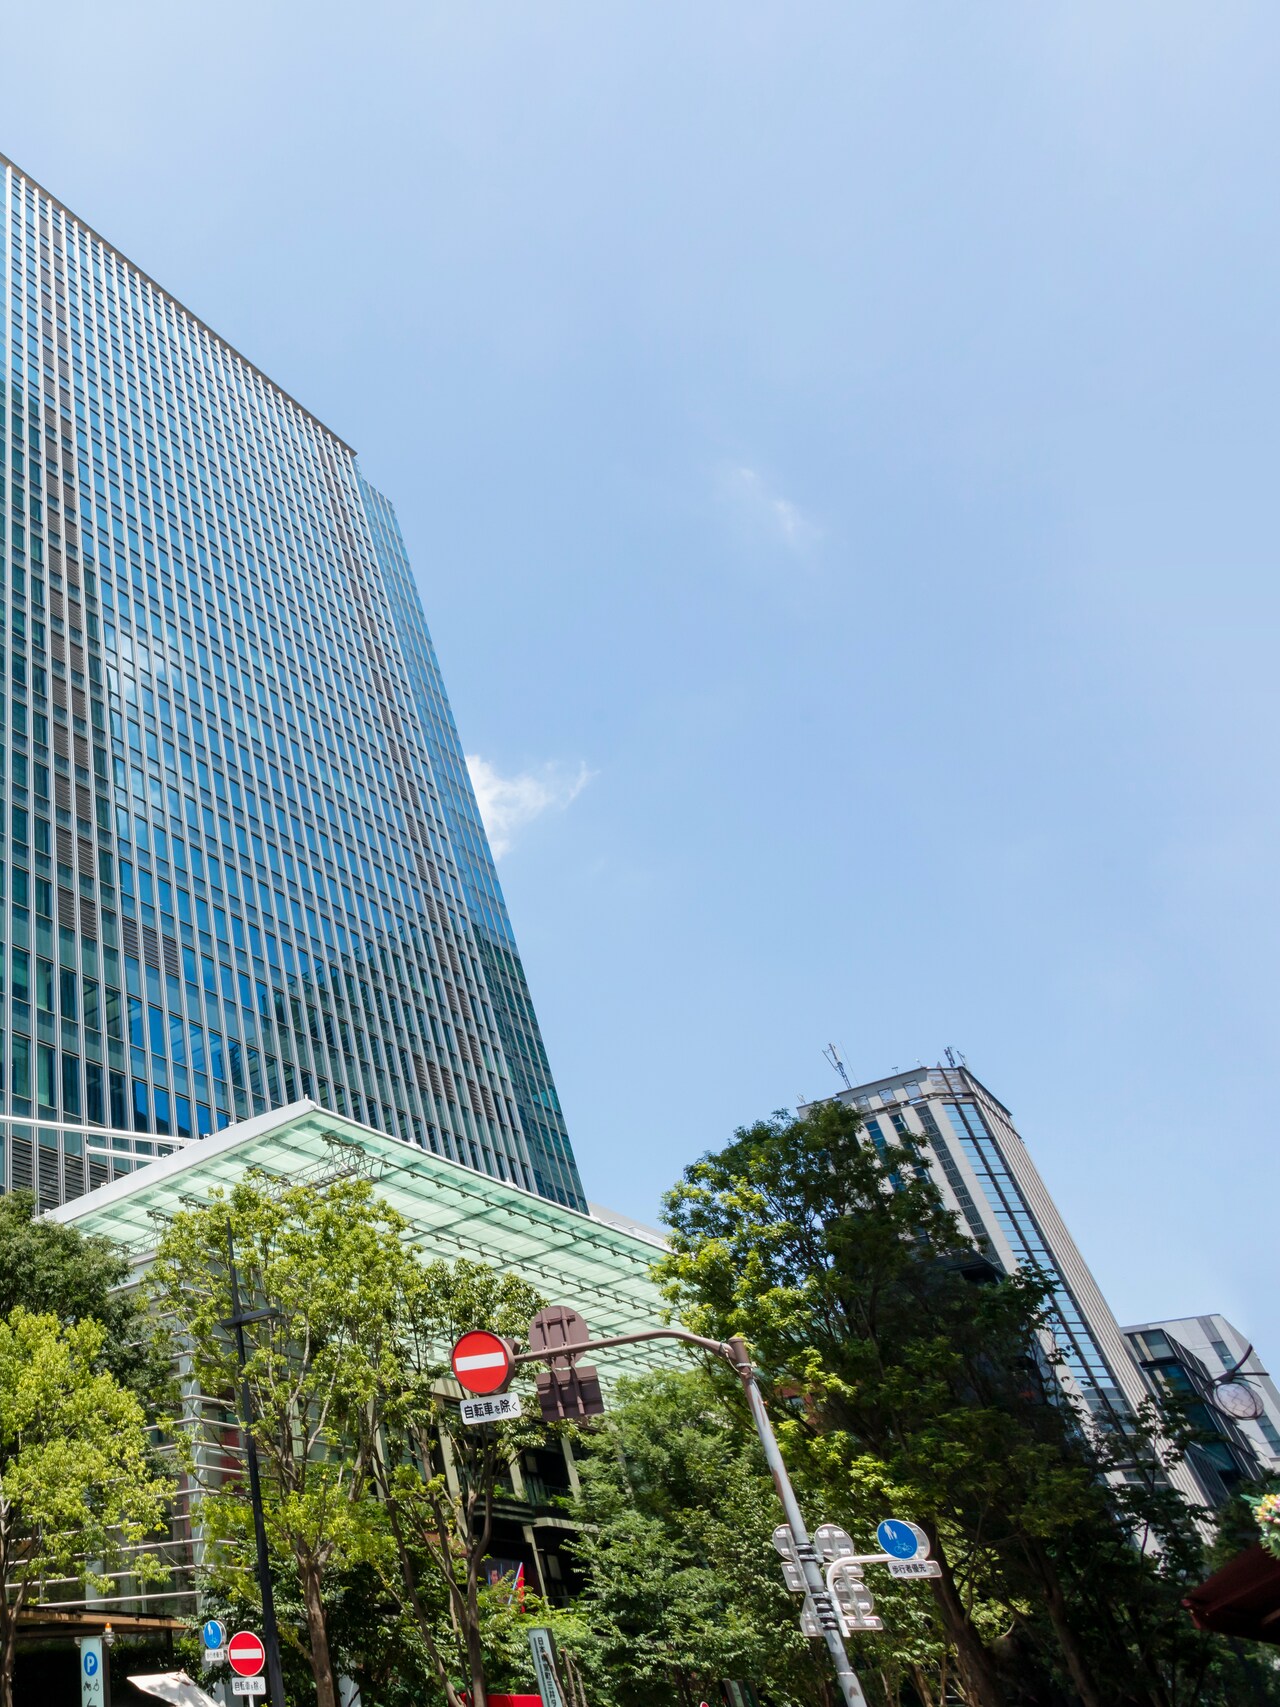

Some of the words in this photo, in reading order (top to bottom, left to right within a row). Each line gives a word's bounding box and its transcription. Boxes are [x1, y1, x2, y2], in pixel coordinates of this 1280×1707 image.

[464, 1398, 518, 1419] 自転車を除く
[892, 1563, 927, 1574] 歩行者優先
